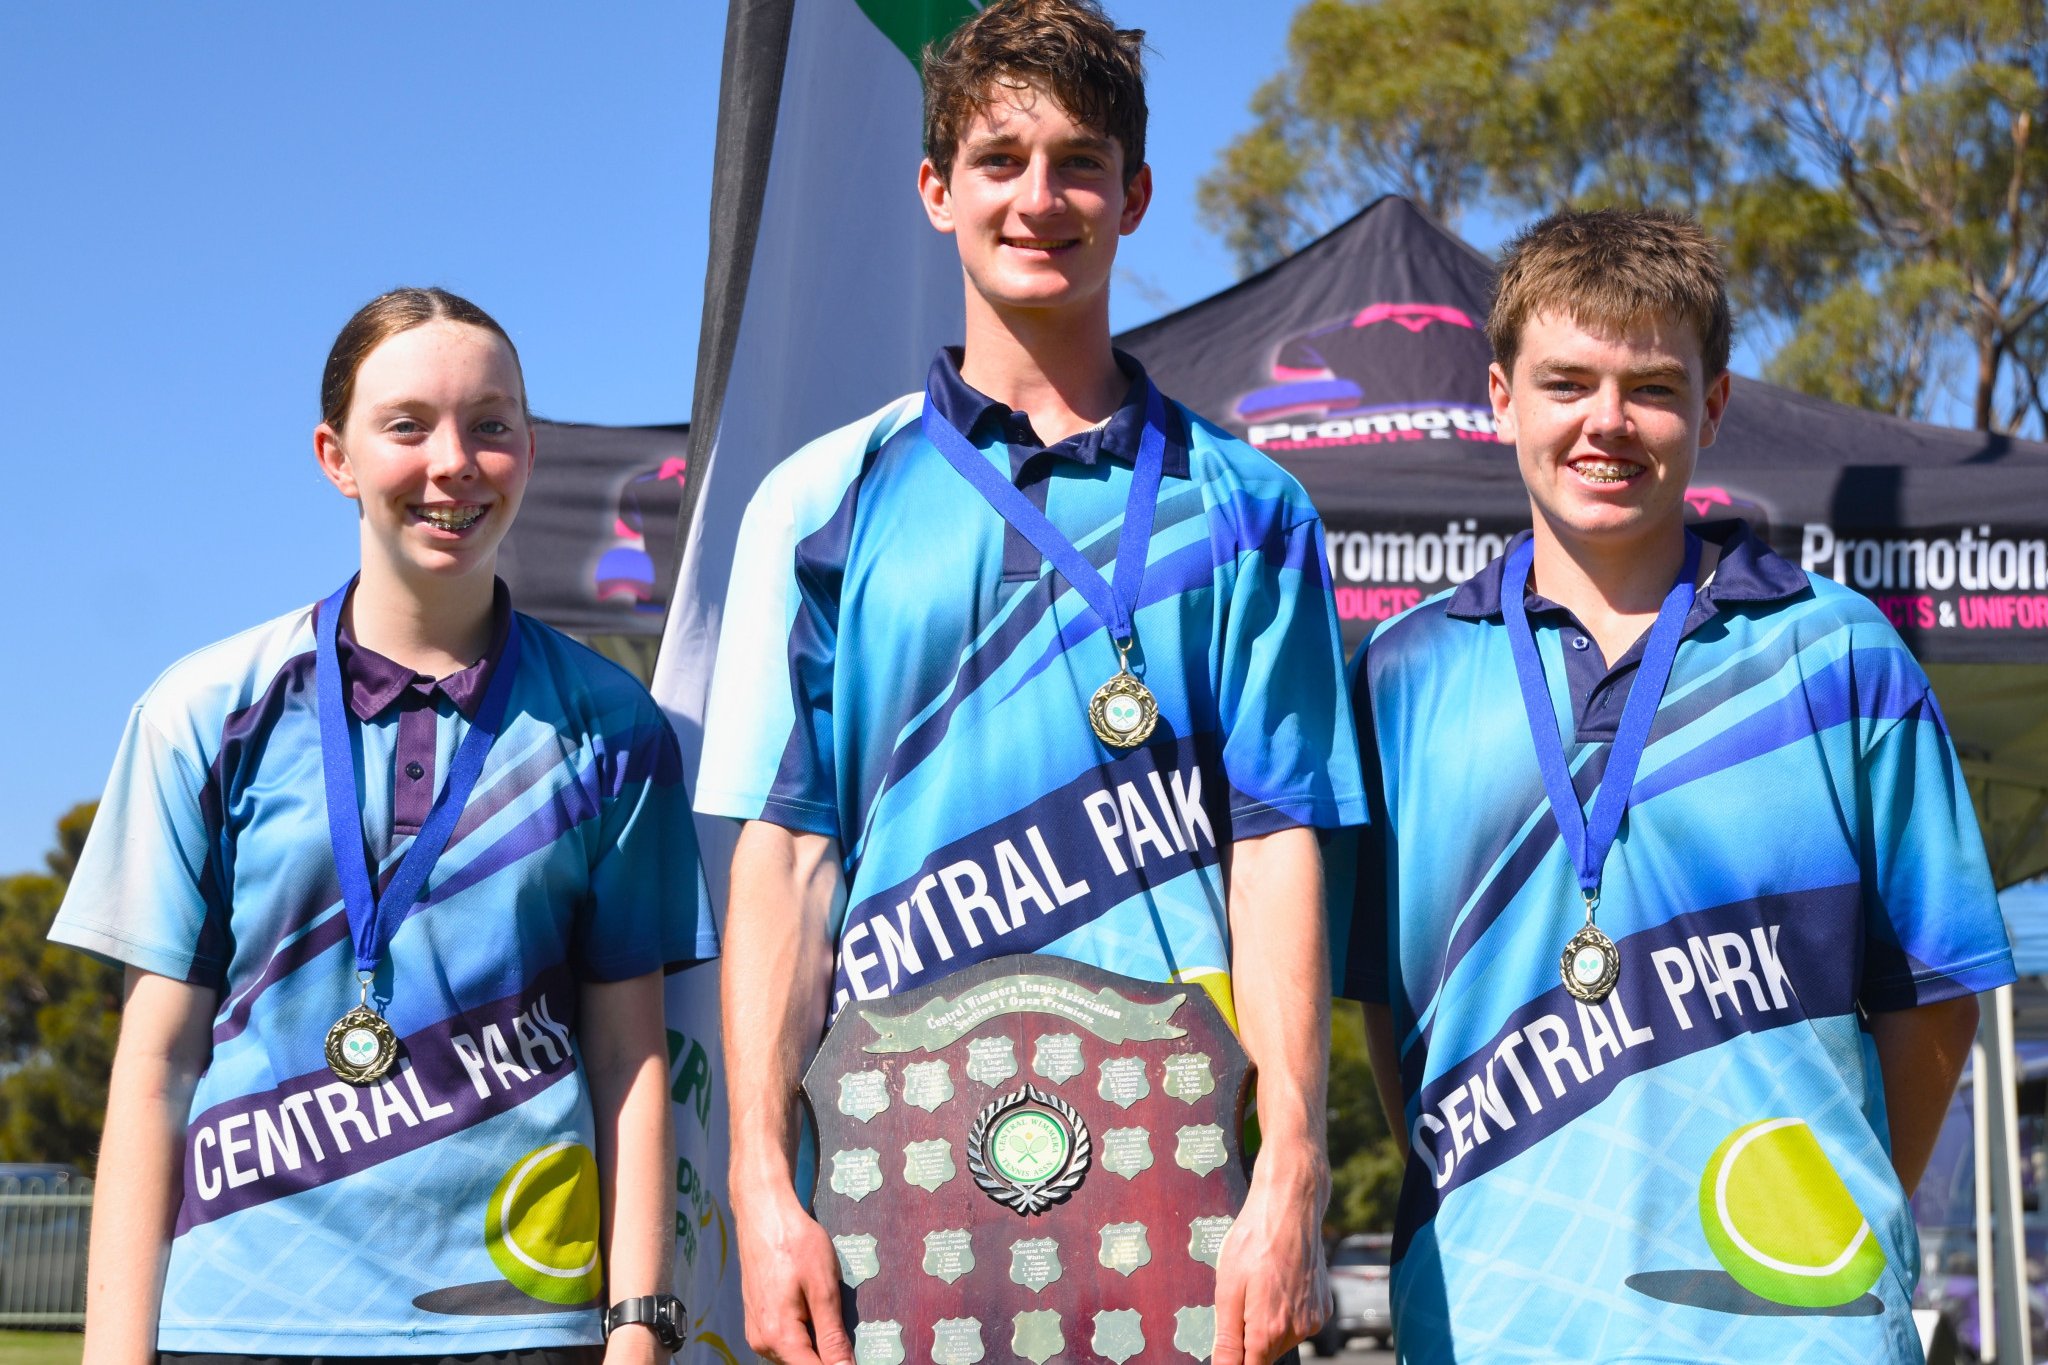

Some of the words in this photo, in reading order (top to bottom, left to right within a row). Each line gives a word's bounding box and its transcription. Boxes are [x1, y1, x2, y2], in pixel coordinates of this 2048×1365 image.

[1249, 408, 1499, 444] Promoti
[1326, 518, 1513, 583] romotio
[1801, 523, 2048, 590] Promotion
[1335, 587, 1421, 620] DUCTS
[1939, 600, 1957, 627] &
[926, 1004, 966, 1030] Central
[1019, 981, 1057, 994] Tennis
[1057, 987, 1121, 1020] Association
[953, 1005, 996, 1031] Section
[1009, 996, 1040, 1007] Open
[1412, 990, 1655, 1189] CENTRAL
[1650, 925, 1799, 1031] PARK
[193, 1057, 453, 1201] CENTRAL
[999, 1119, 1026, 1152] CENTRAL
[1031, 1119, 1059, 1153] WIMMERA
[1002, 1157, 1030, 1176] TENNIS
